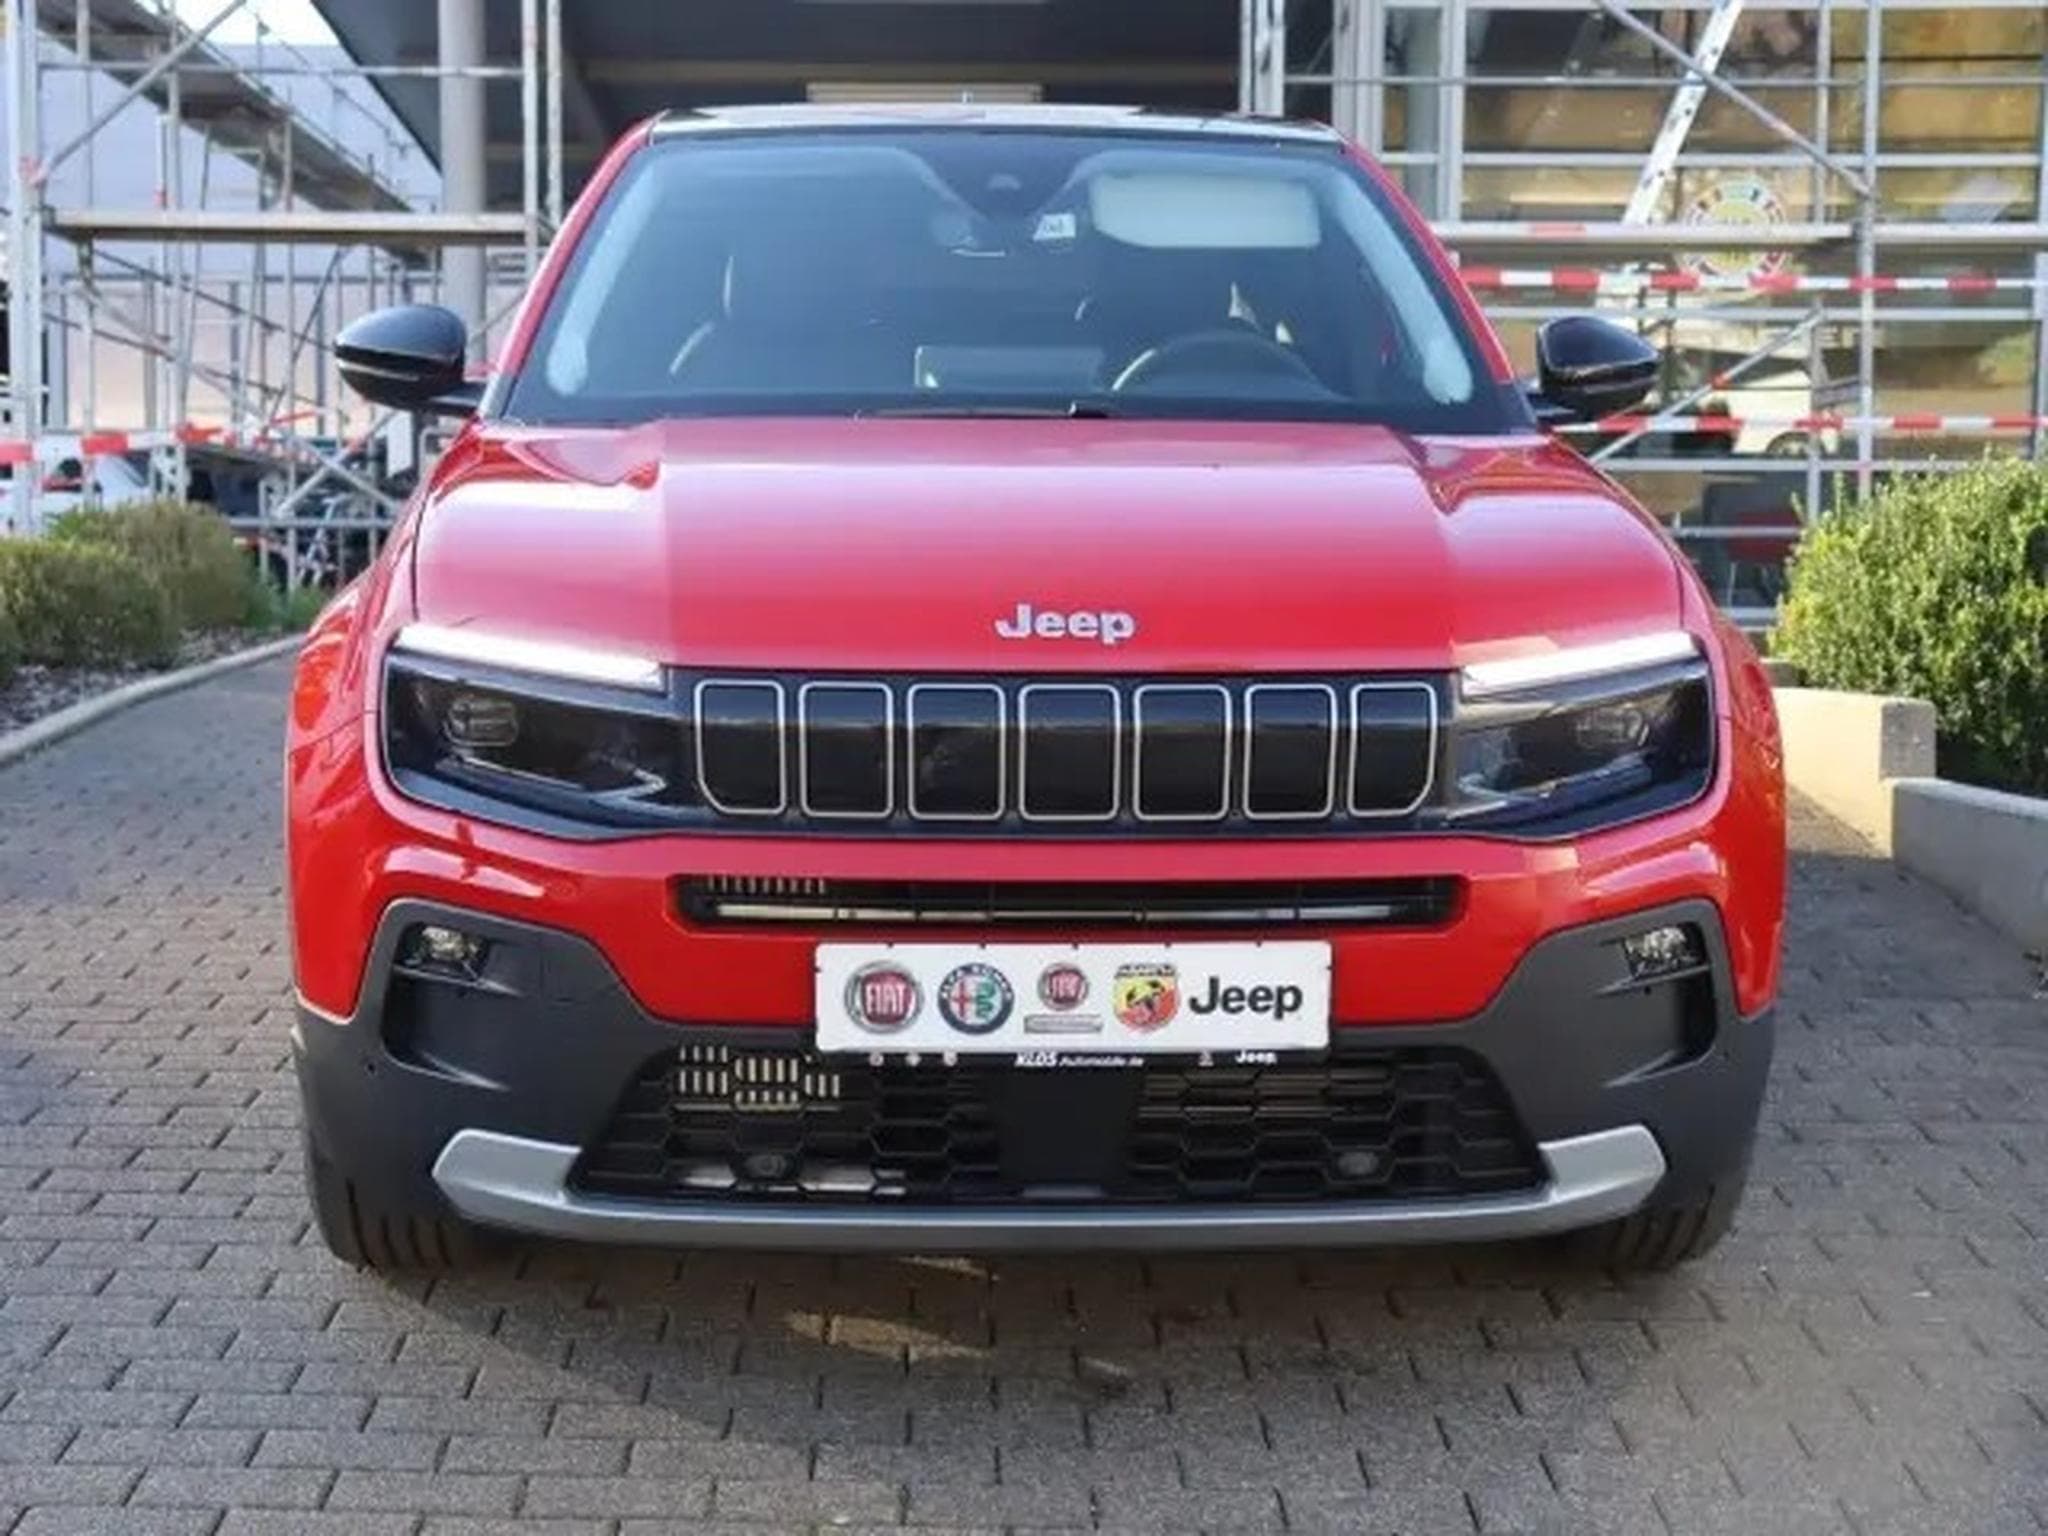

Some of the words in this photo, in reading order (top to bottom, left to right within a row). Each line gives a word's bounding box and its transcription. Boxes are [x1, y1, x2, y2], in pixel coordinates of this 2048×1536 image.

[995, 603, 1135, 645] Jeep
[866, 983, 906, 1015] FIAT
[1188, 976, 1303, 1020] Jeep
